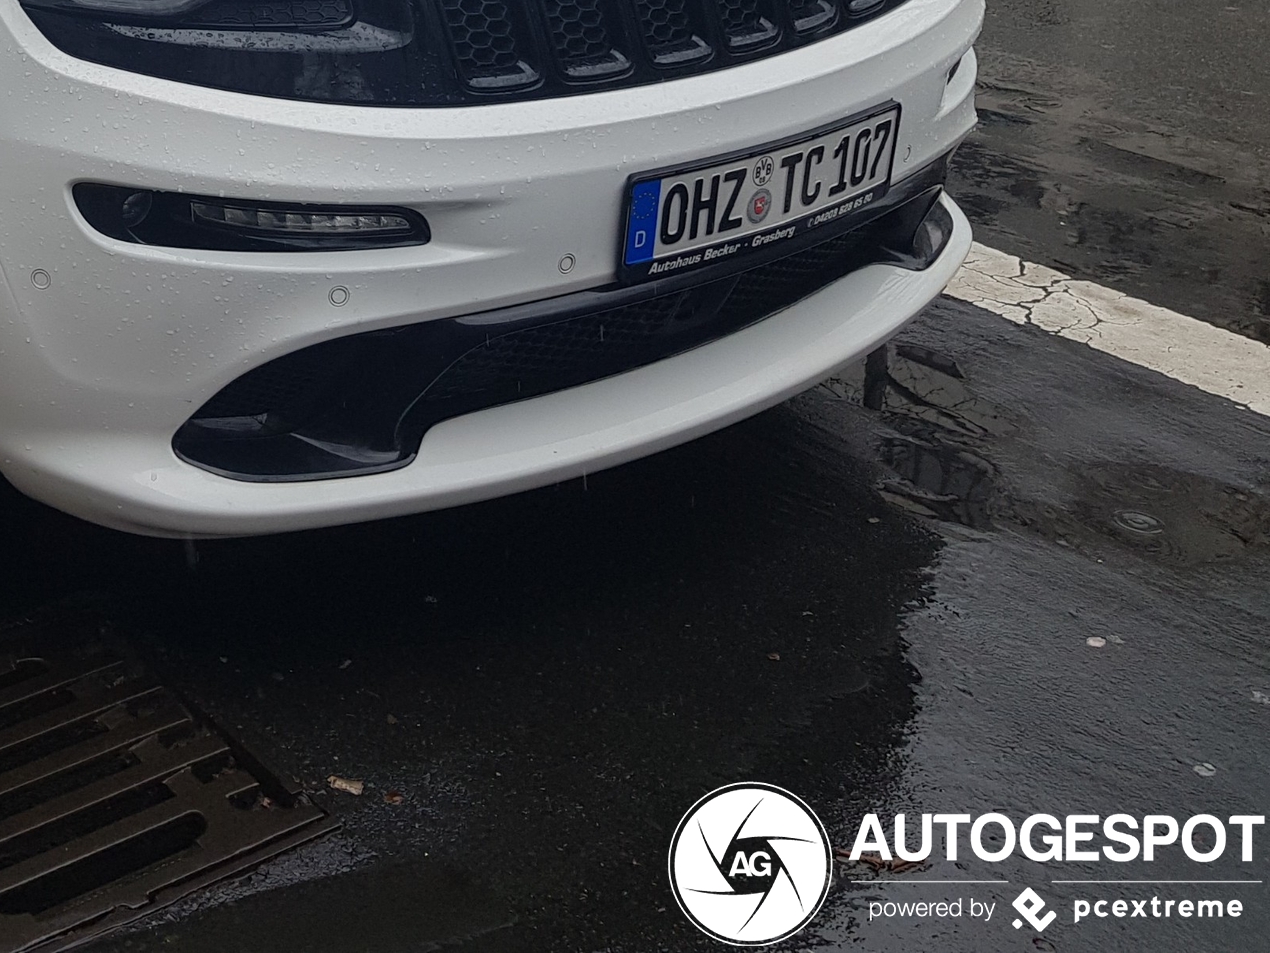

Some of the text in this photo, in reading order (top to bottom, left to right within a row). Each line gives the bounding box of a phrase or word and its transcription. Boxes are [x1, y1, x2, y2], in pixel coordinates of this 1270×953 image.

[660, 118, 892, 246] OHZ TC 107
[755, 158, 773, 180] BVB
[635, 230, 647, 248] D
[648, 226, 796, 275] Autohaus Becker Grasberg
